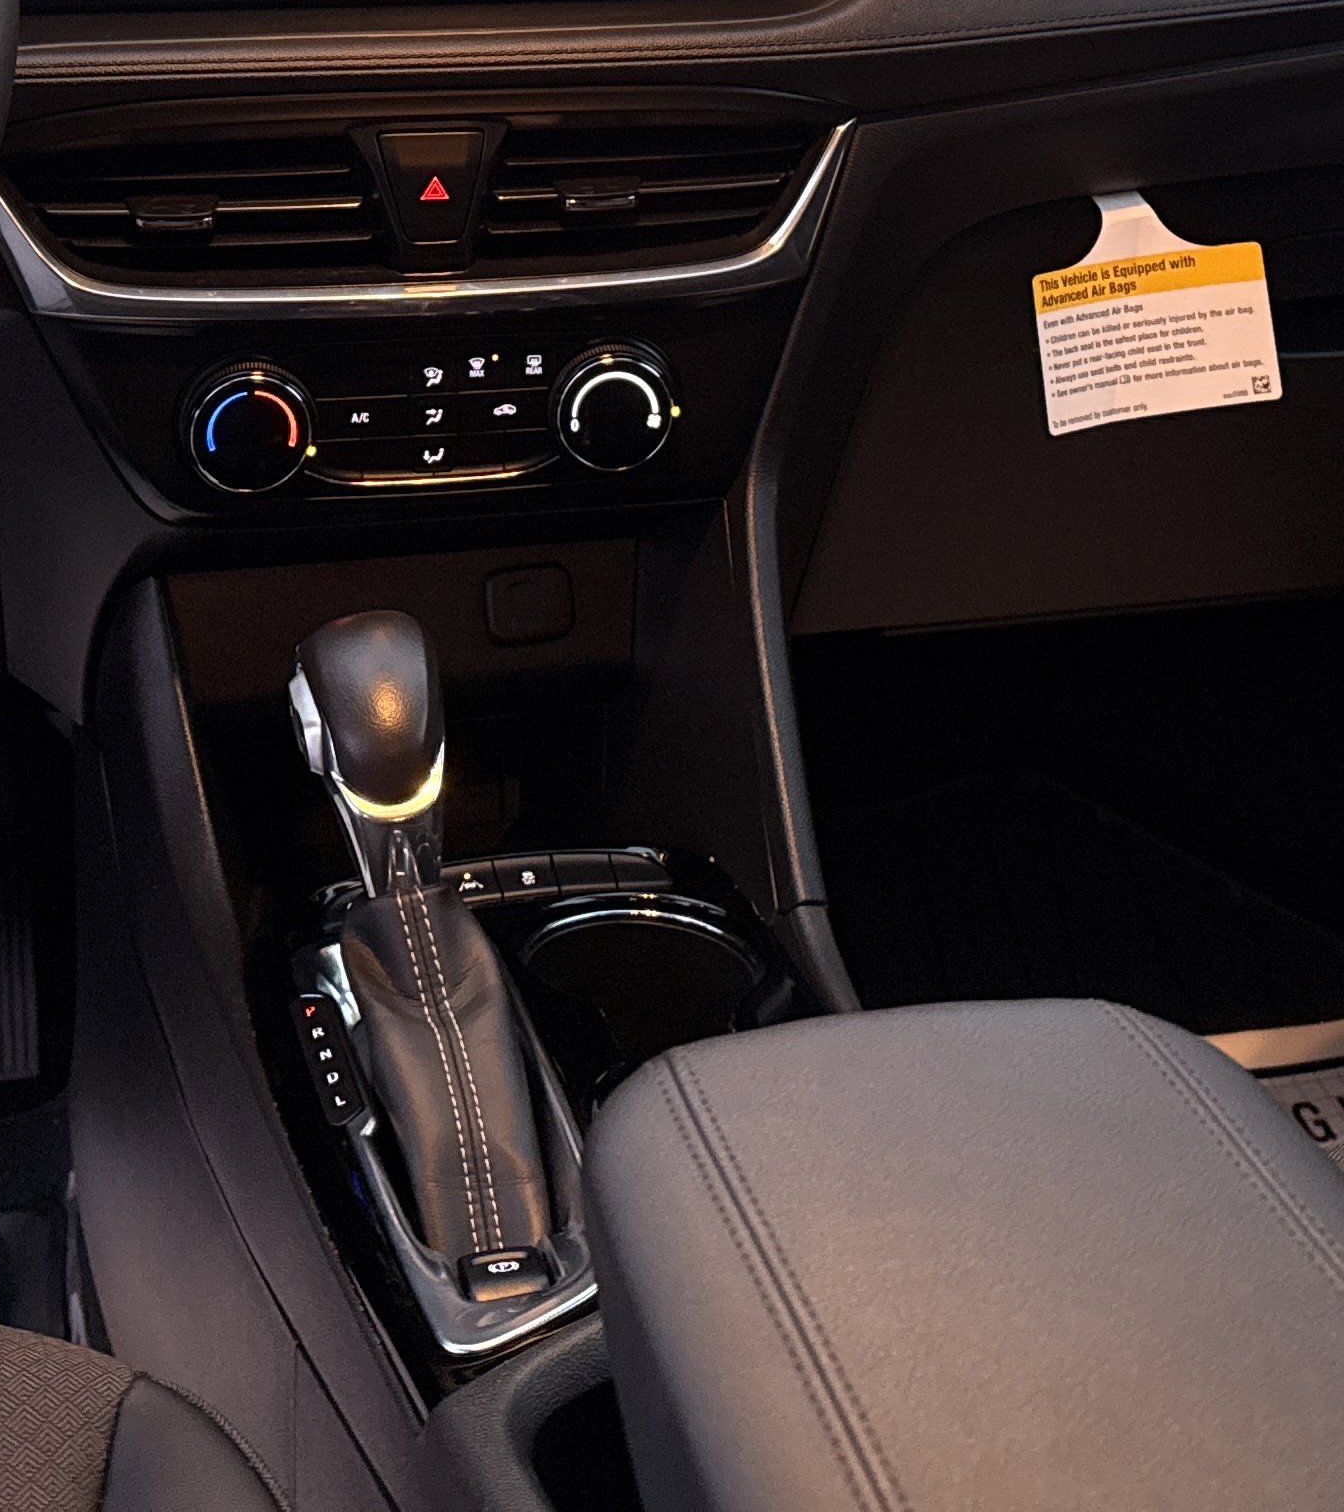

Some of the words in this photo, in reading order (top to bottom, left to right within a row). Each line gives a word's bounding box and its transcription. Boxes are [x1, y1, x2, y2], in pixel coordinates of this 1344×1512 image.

[1039, 279, 1060, 293] This
[1061, 270, 1099, 288] Vehicle
[1101, 268, 1111, 280] is
[1113, 259, 1166, 279] Equipped
[1169, 255, 1196, 269] with
[1041, 287, 1088, 308] Advanced
[1092, 284, 1107, 297] Air
[1109, 281, 1137, 295] Bags
[1050, 333, 1076, 345] Children
[1078, 330, 1090, 338] can
[1132, 317, 1167, 328] seriously
[1168, 312, 1196, 324] injured
[1198, 311, 1208, 320] by
[1209, 309, 1223, 318] the
[1225, 308, 1235, 316] air
[1076, 308, 1111, 322] Advanced
[1112, 307, 1122, 316] Air
[1124, 304, 1144, 314] Bags
[1102, 339, 1114, 347] the
[1138, 332, 1158, 342] place
[1159, 330, 1170, 338] for
[351, 412, 370, 424] A/C
[312, 1027, 325, 1039] R
[319, 1048, 333, 1061] N
[326, 1072, 339, 1084] D
[335, 1095, 347, 1107] L
